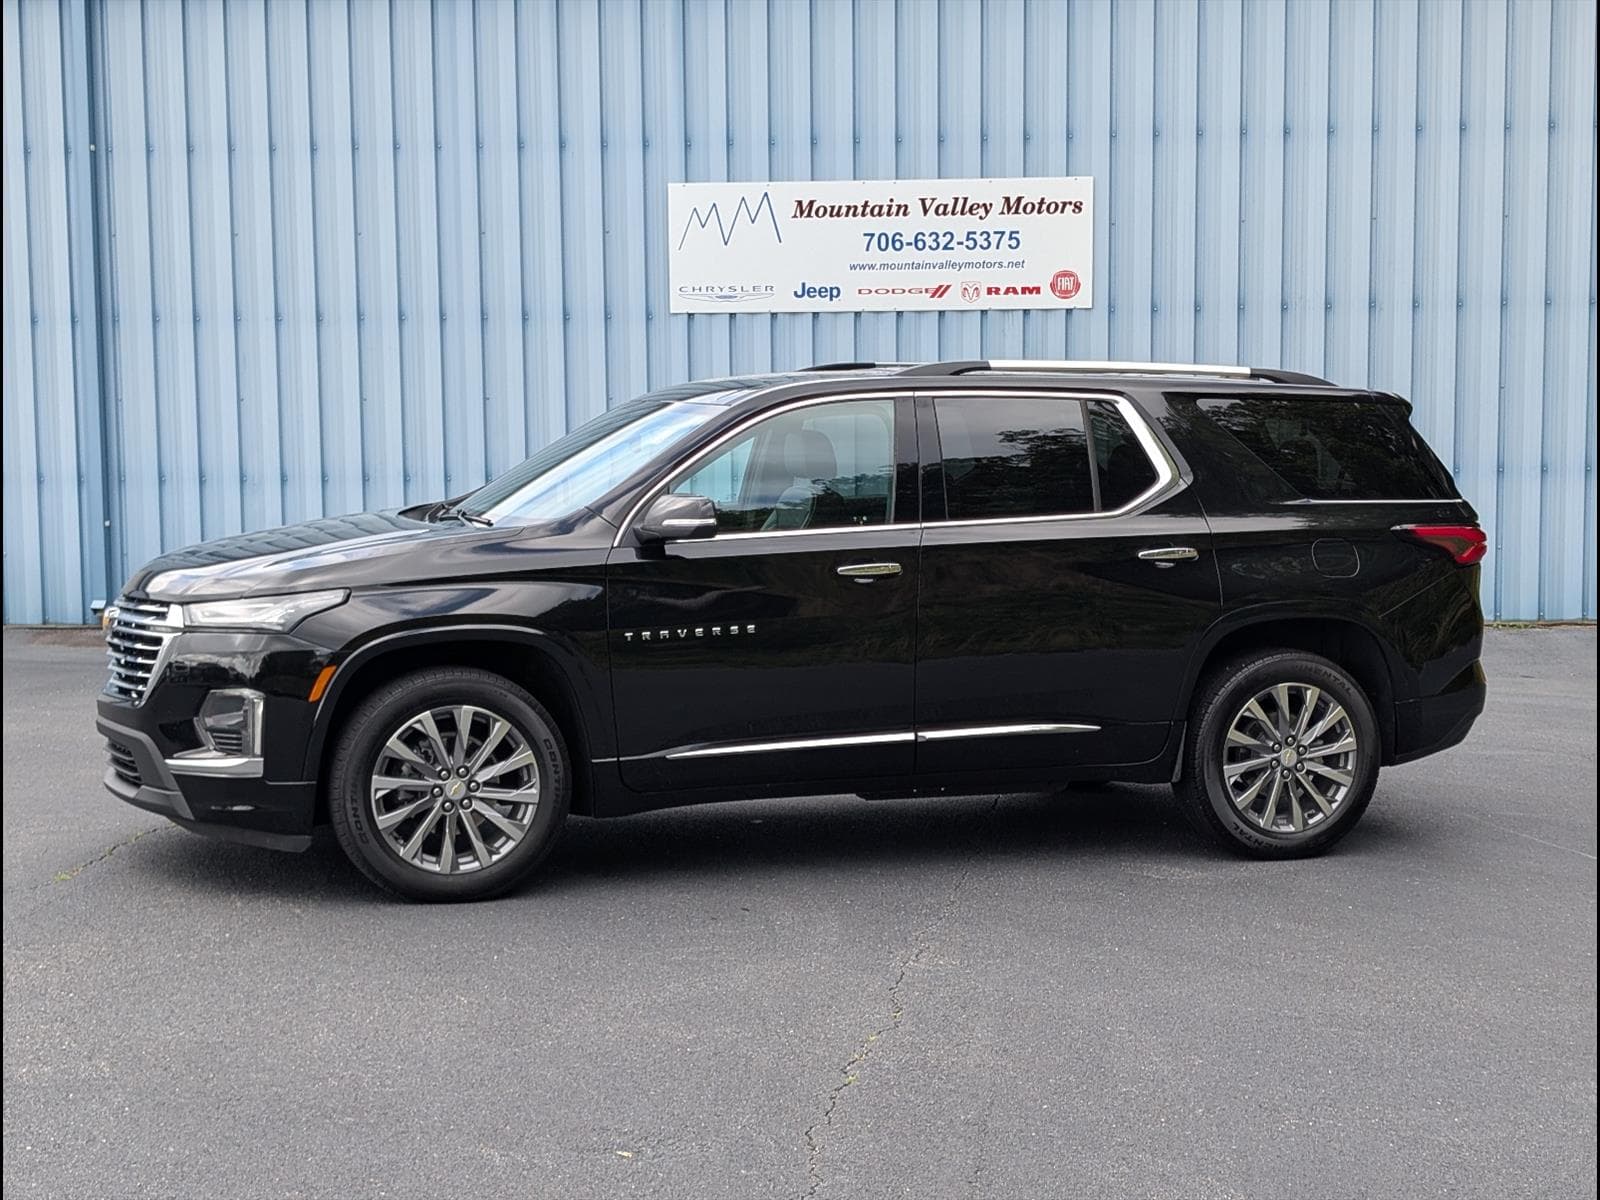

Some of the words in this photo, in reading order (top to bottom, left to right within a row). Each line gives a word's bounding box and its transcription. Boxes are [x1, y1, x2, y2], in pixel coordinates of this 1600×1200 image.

[791, 198, 910, 219] Mountain
[918, 196, 993, 220] Valley
[998, 195, 1084, 216] Motors
[862, 230, 1022, 253] 706-632-5375
[849, 258, 1026, 273] www.mountainvalleymotors.net
[678, 285, 775, 294] CHRYSLER
[793, 281, 842, 301] Jeep
[857, 286, 934, 296] DODGE
[986, 286, 1041, 296] RAM
[1057, 276, 1075, 291] FIAT
[624, 624, 756, 642] TRAVERSE
